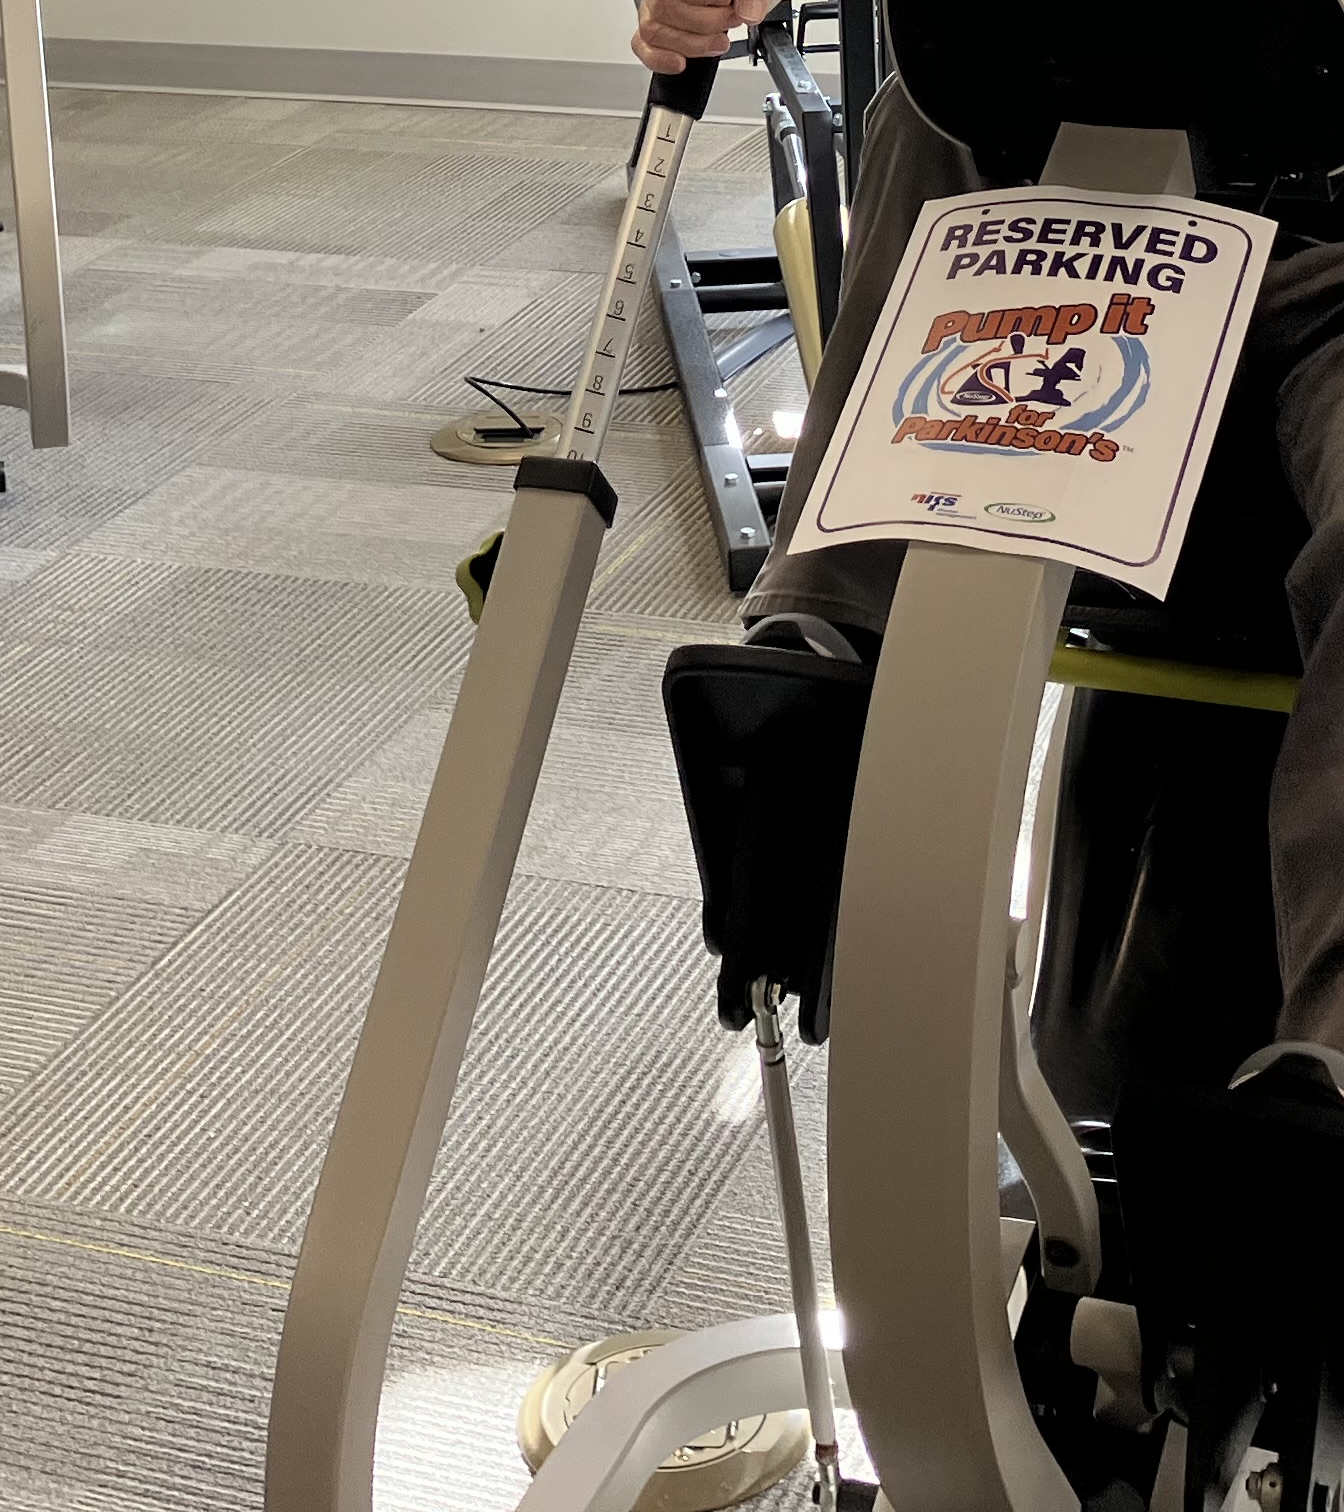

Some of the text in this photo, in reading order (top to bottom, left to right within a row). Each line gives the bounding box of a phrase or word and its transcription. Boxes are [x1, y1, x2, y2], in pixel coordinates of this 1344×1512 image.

[653, 158, 665, 173] 2
[643, 193, 655, 208] 3
[634, 228, 645, 243] 4
[940, 216, 1219, 265] RESERVED
[624, 263, 636, 280] 5
[946, 248, 1187, 295] PARKING
[921, 293, 1155, 355] Pump it
[592, 375, 604, 391] 8
[1005, 404, 1055, 428] for
[891, 416, 1120, 462] Parkinson's
